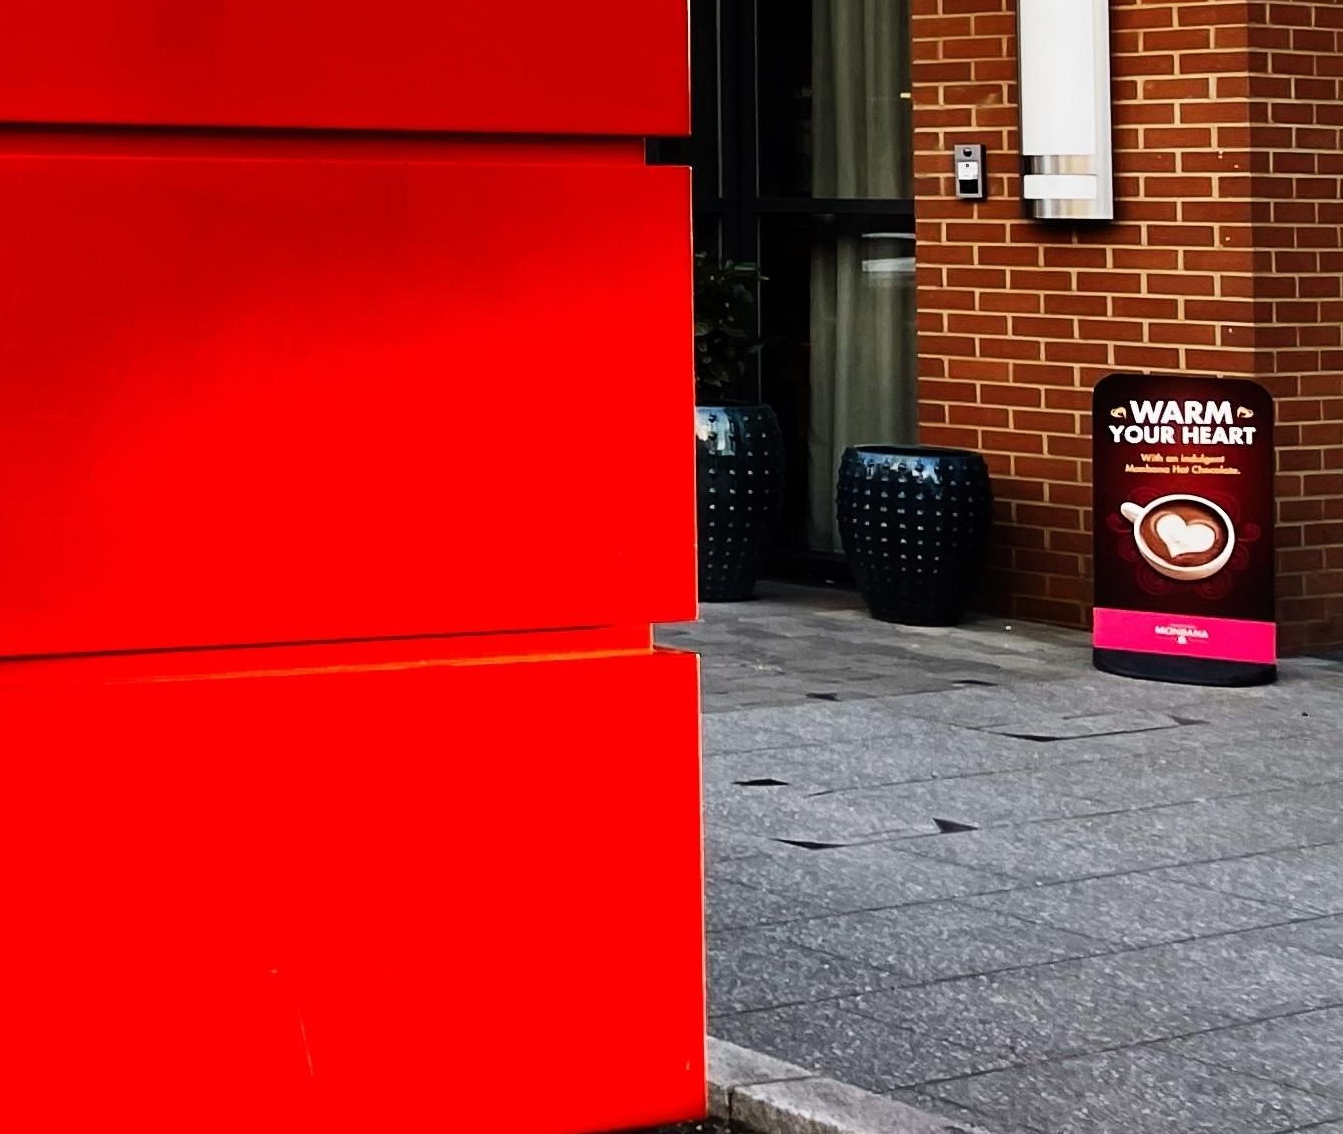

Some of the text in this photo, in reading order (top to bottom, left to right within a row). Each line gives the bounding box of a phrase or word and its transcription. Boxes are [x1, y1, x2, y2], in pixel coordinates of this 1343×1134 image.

[1129, 400, 1235, 425] WARM
[1109, 425, 1257, 445] YOUR HEART
[1140, 453, 1164, 462] With
[1172, 465, 1190, 474] Hot
